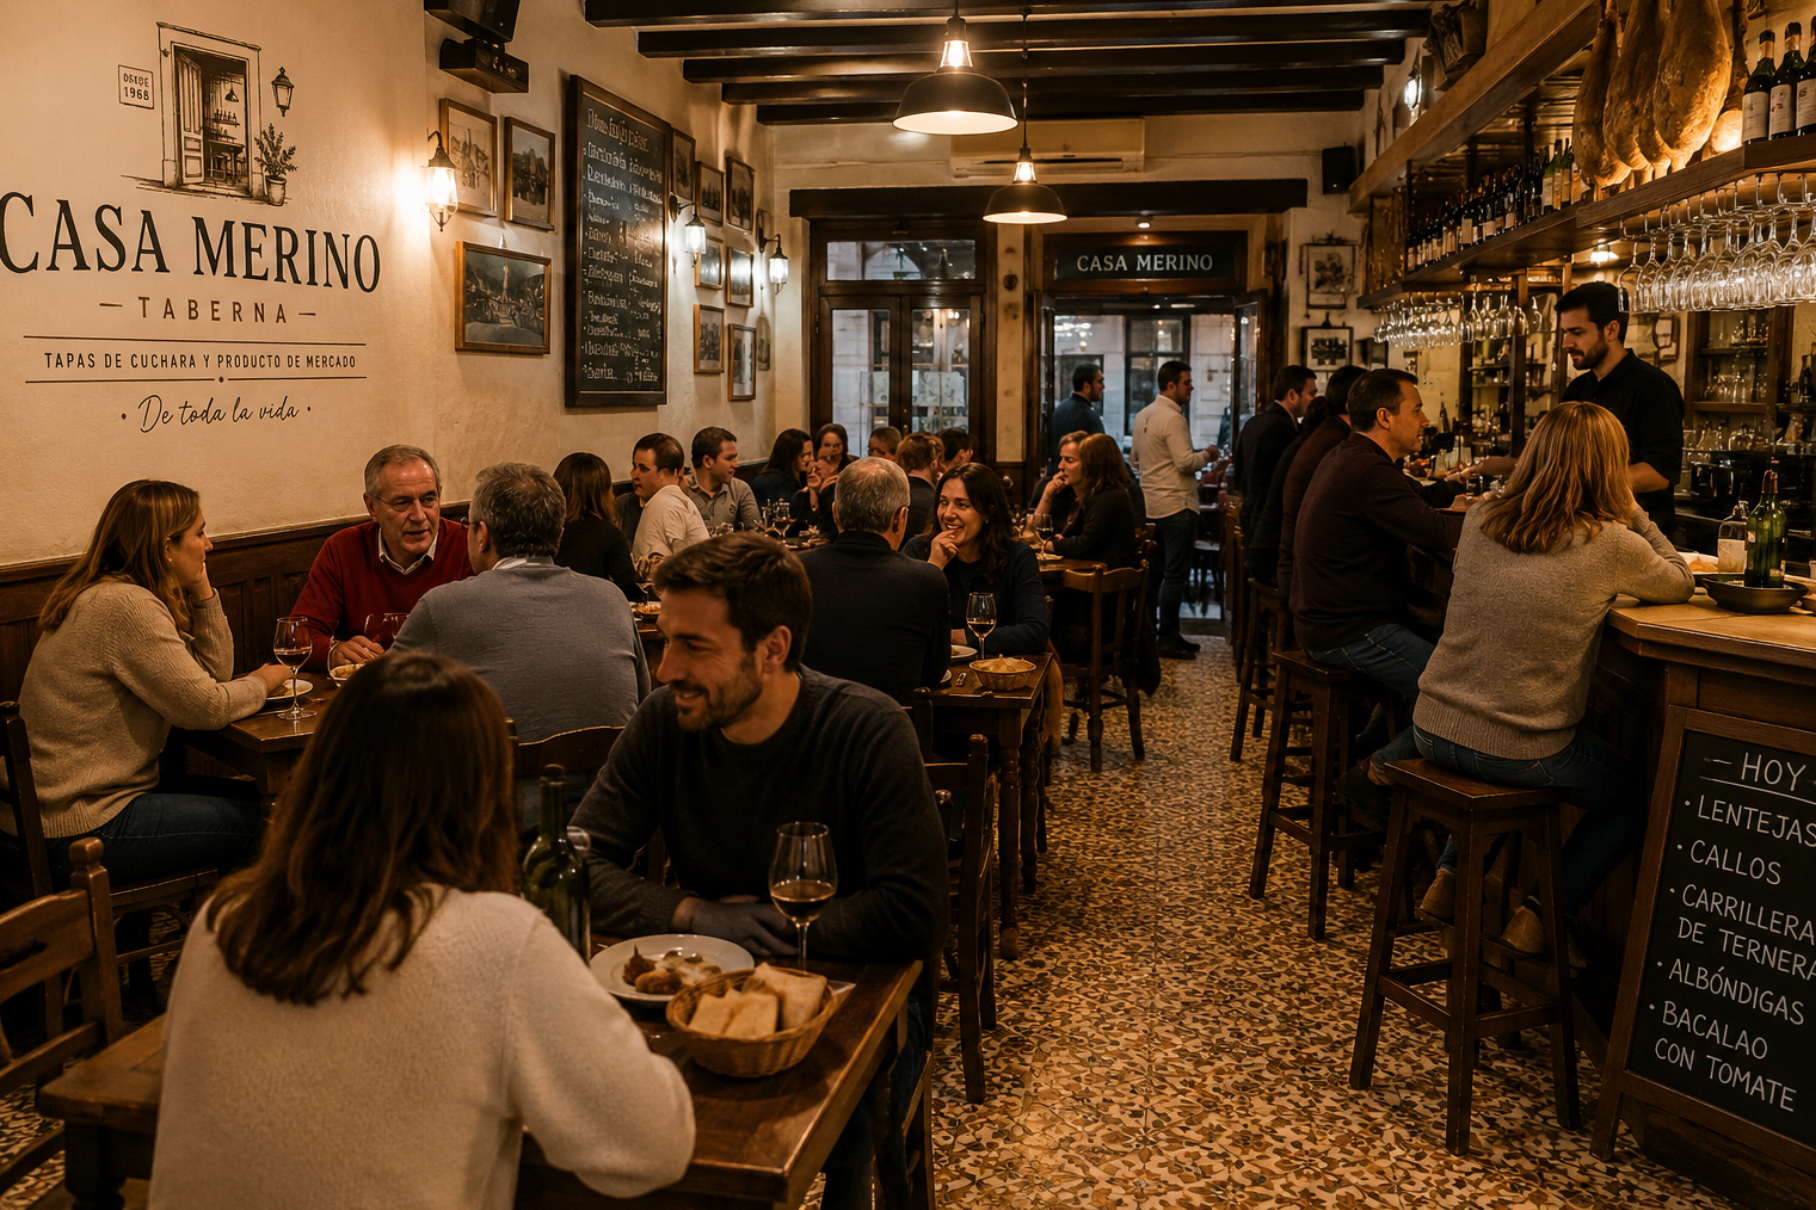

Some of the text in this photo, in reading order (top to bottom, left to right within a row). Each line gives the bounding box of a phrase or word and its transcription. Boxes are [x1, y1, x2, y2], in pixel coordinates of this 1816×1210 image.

[124, 86, 150, 101] 1968
[0, 192, 380, 292] CASA MERINO
[1076, 254, 1213, 272] CASA MERINO
[138, 296, 287, 323] TABERNA
[44, 352, 357, 369] TAPAS DE CUCHARA Y PRODUCTO DE MERCADO
[138, 395, 300, 433] De toda la vida
[1741, 752, 1807, 792] HOY
[1697, 794, 1816, 848] LENTEJAS
[1690, 839, 1781, 885] CALLOS
[1678, 916, 1706, 944] DE
[1682, 884, 1816, 946] CARRILLERA
[1668, 958, 1804, 1025] ALBÓNDIGAS
[1662, 1001, 1768, 1059] BACALAO
[1655, 1037, 1797, 1112] CON TOMATE
